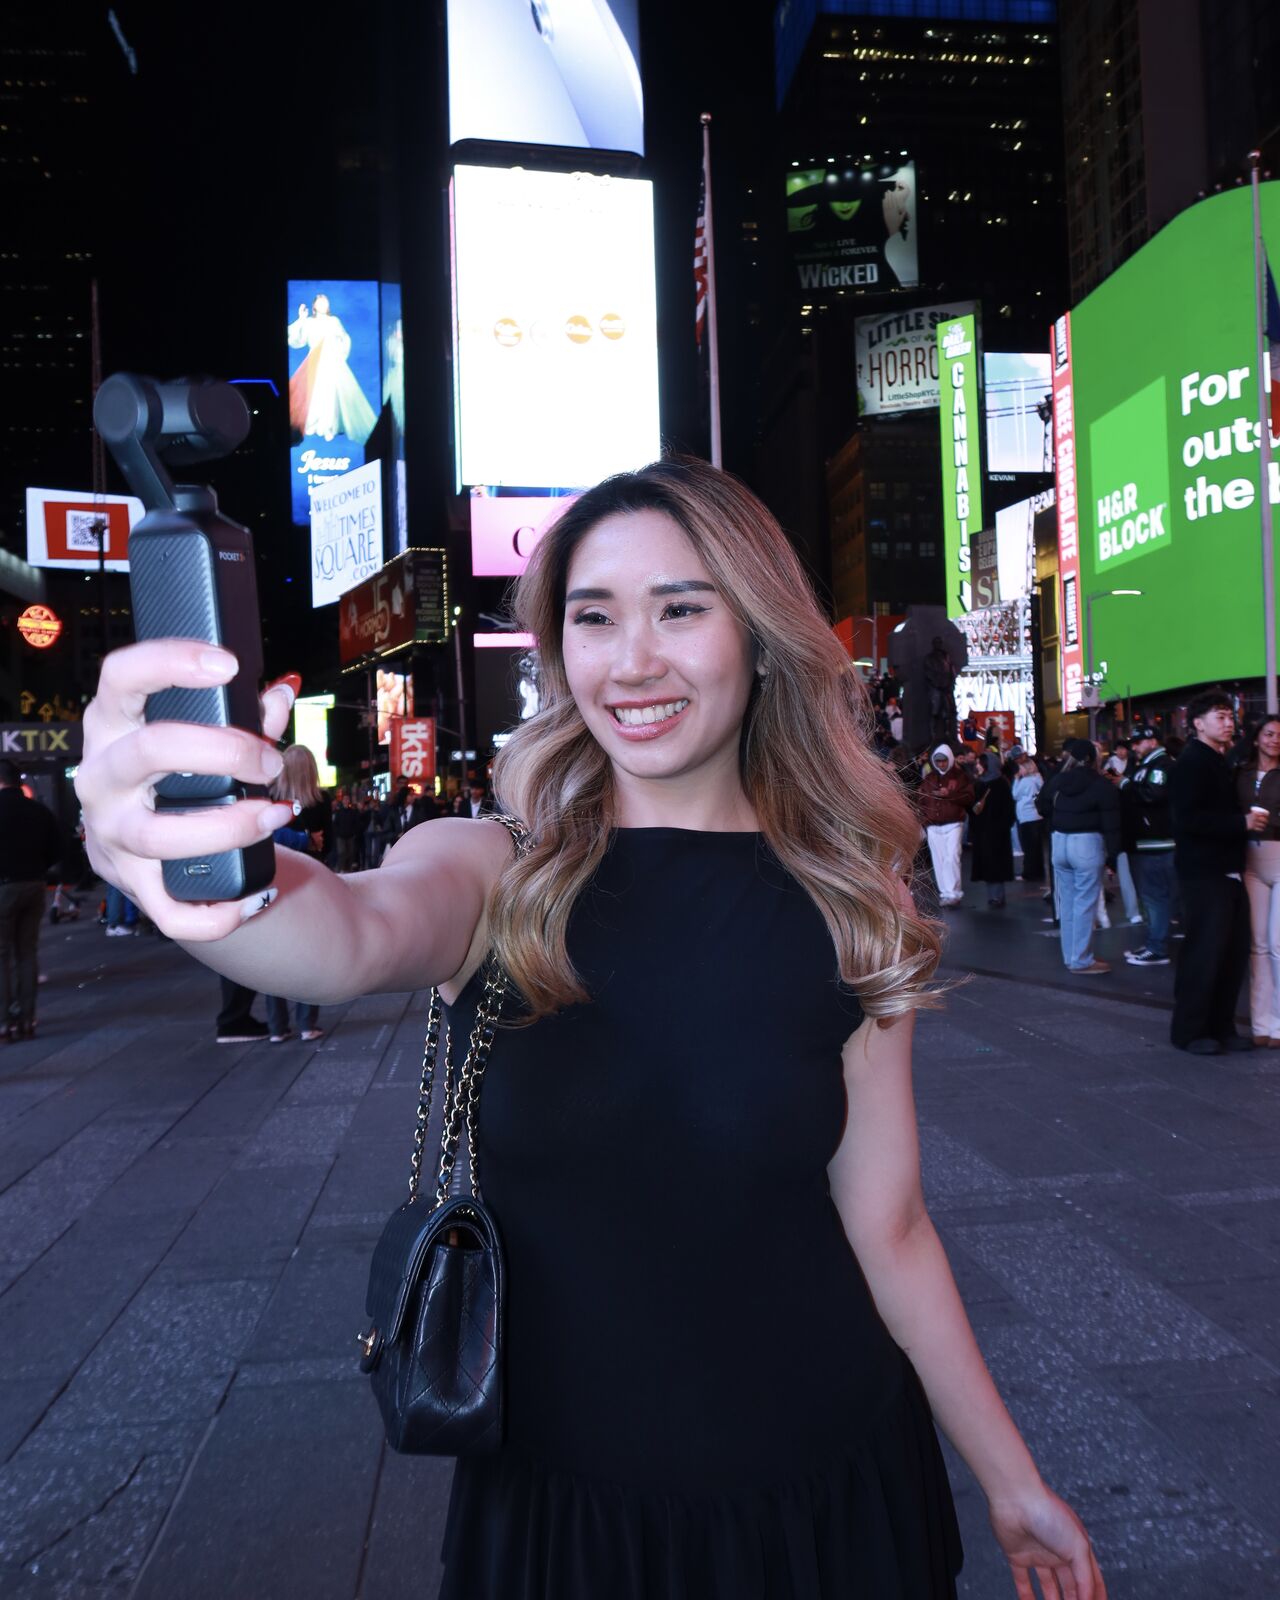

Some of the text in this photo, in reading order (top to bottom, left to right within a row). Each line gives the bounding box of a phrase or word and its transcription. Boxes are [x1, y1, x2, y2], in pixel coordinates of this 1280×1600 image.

[868, 312, 925, 350] LITTLE
[868, 344, 939, 402] HORRO
[1181, 366, 1250, 416] For
[297, 450, 351, 474] Jesus
[951, 361, 971, 573] CANNABIS
[1055, 384, 1077, 561] FREE CHOCOLATE
[313, 487, 360, 514] WELCOME
[362, 480, 376, 496] TO
[1097, 482, 1138, 527] H&R
[1184, 476, 1255, 521] the
[339, 504, 377, 537] TIMES
[219, 551, 239, 561] POCKET
[315, 528, 376, 580] SQUARE
[0, 729, 70, 752] KTIX
[401, 722, 429, 777] tkts
